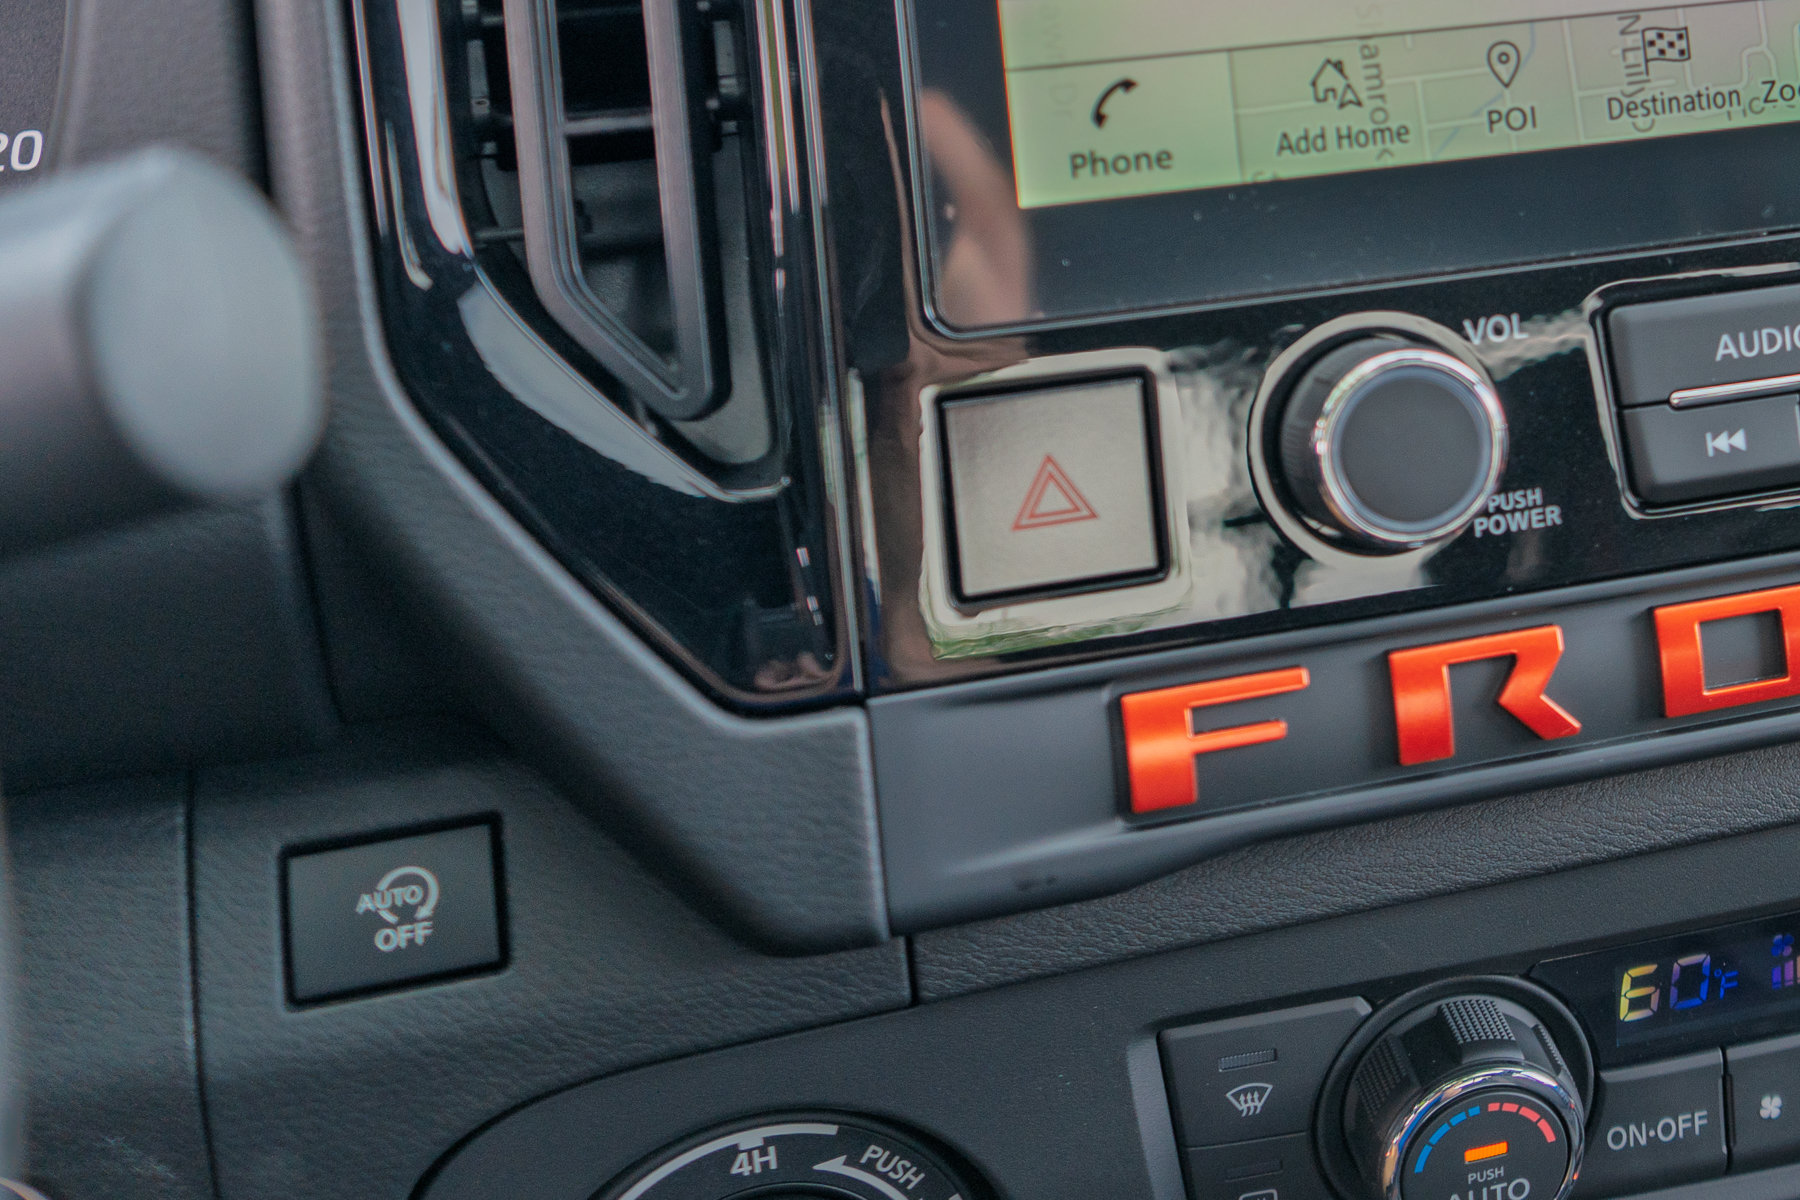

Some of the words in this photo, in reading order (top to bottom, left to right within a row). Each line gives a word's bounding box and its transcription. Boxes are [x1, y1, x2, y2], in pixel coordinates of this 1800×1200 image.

[1607, 86, 1741, 120] Destination
[1486, 107, 1537, 132] POI
[1277, 127, 1328, 156] Add
[1335, 119, 1410, 150] Home
[1069, 148, 1173, 179] Phone
[1462, 314, 1529, 346] VOL
[1487, 488, 1544, 512] PUSH
[1473, 505, 1562, 537] POWER
[356, 884, 423, 914] AUTO
[374, 921, 433, 952] OFF
[730, 1146, 777, 1176] 4H
[859, 1144, 925, 1190] PUSH
[1468, 1166, 1504, 1184] PUSH
